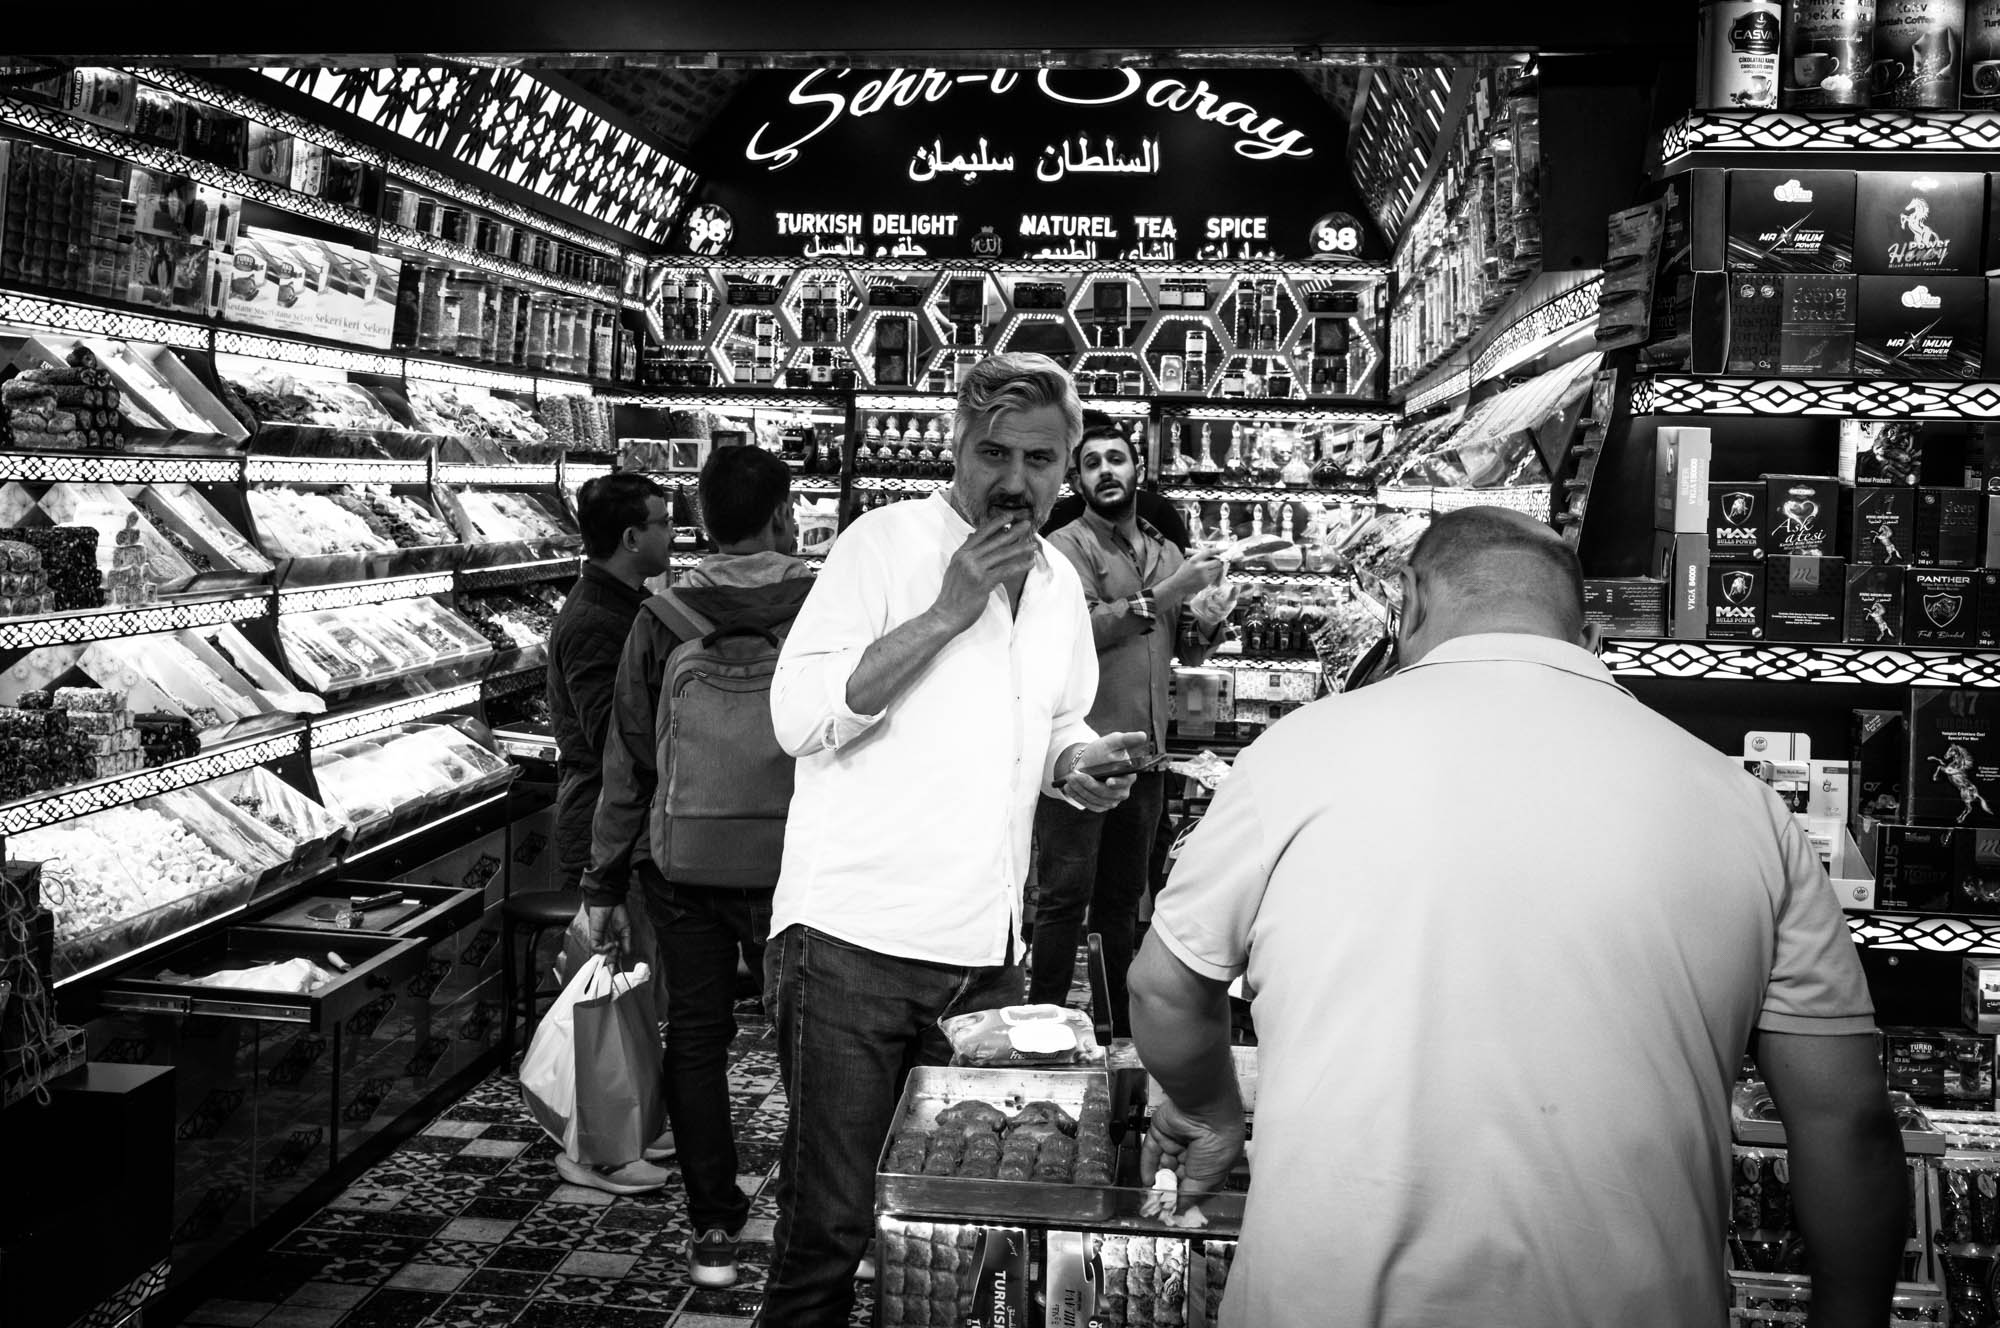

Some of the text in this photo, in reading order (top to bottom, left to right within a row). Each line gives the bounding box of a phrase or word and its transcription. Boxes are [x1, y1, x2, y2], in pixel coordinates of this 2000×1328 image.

[1036, 131, 1160, 182] السلطان
[775, 211, 959, 236] TURKISH DELIGHT
[1019, 215, 1269, 240] NATUREL TEA SPICE
[1316, 227, 1358, 251] 38
[1716, 527, 1757, 539] MAX
[1916, 575, 1971, 584] PANTHER
[1715, 606, 1756, 618] MAX
[1882, 844, 1899, 889] PLUS
[1910, 1043, 1932, 1051] TURKO
